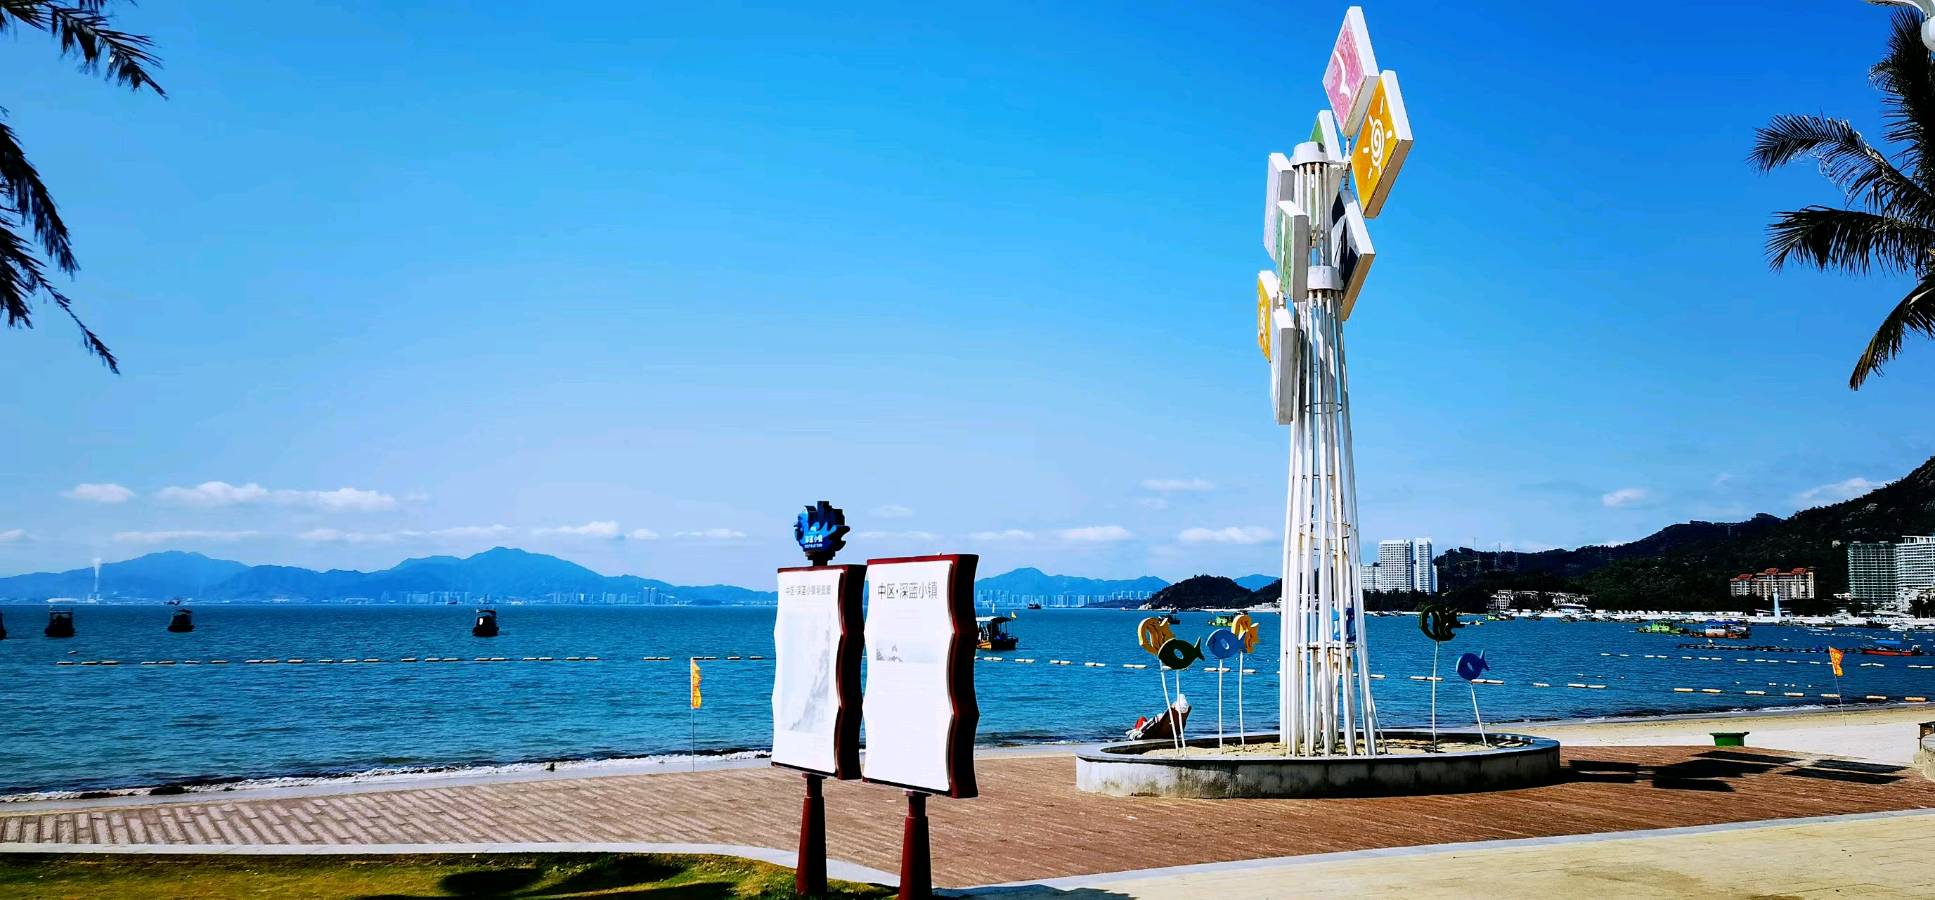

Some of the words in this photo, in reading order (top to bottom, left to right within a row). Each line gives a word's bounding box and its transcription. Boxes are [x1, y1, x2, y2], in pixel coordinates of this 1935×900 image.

[878, 581, 938, 599] 中区·深蓝小镇
